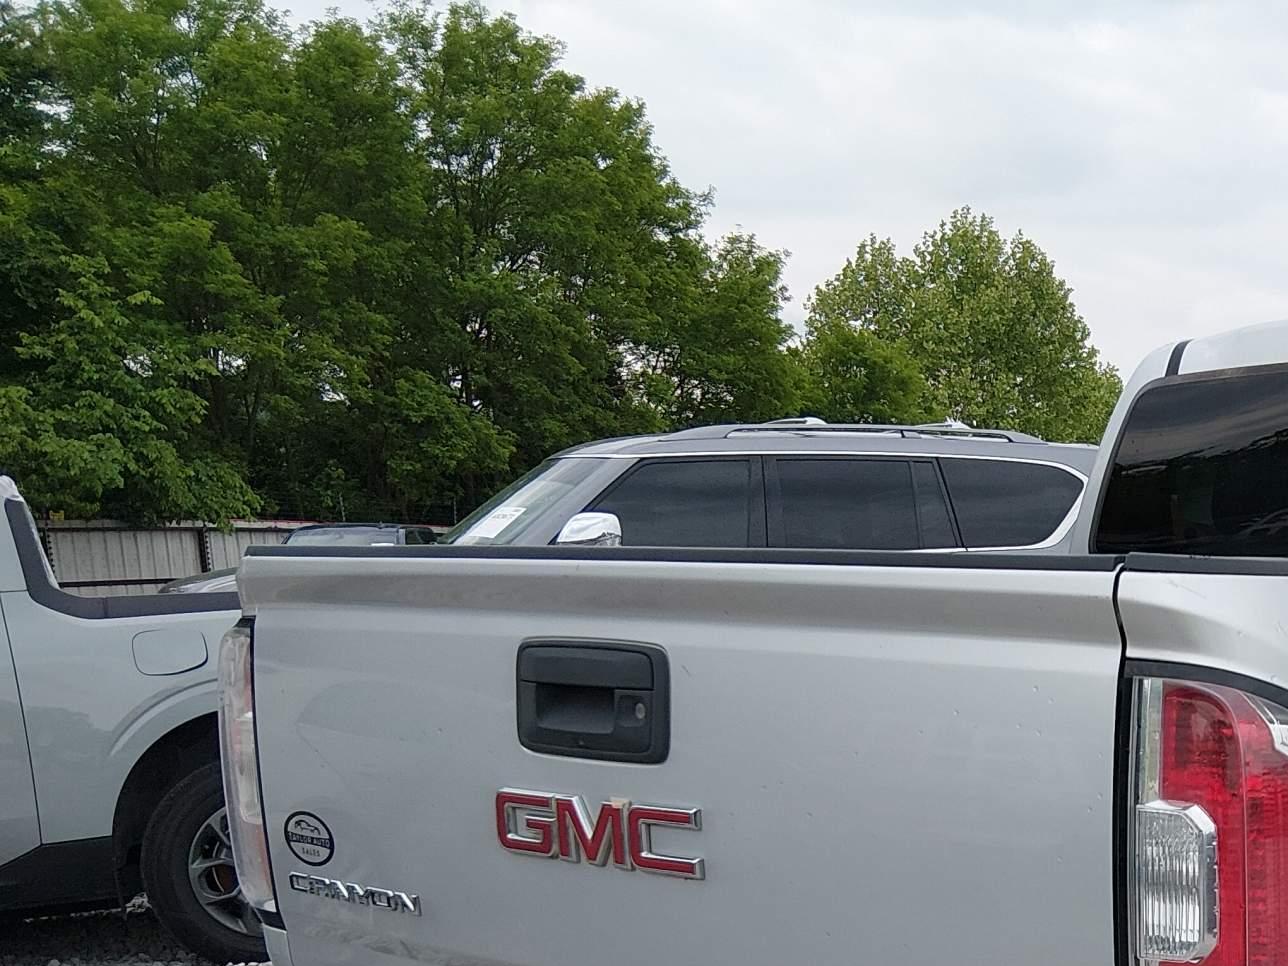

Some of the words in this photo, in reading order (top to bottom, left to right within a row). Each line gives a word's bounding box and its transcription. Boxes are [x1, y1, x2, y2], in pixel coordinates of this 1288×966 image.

[312, 837, 331, 848] AUTO
[496, 787, 705, 880] GMC
[302, 847, 321, 857] SALES
[288, 871, 423, 917] CANYON
